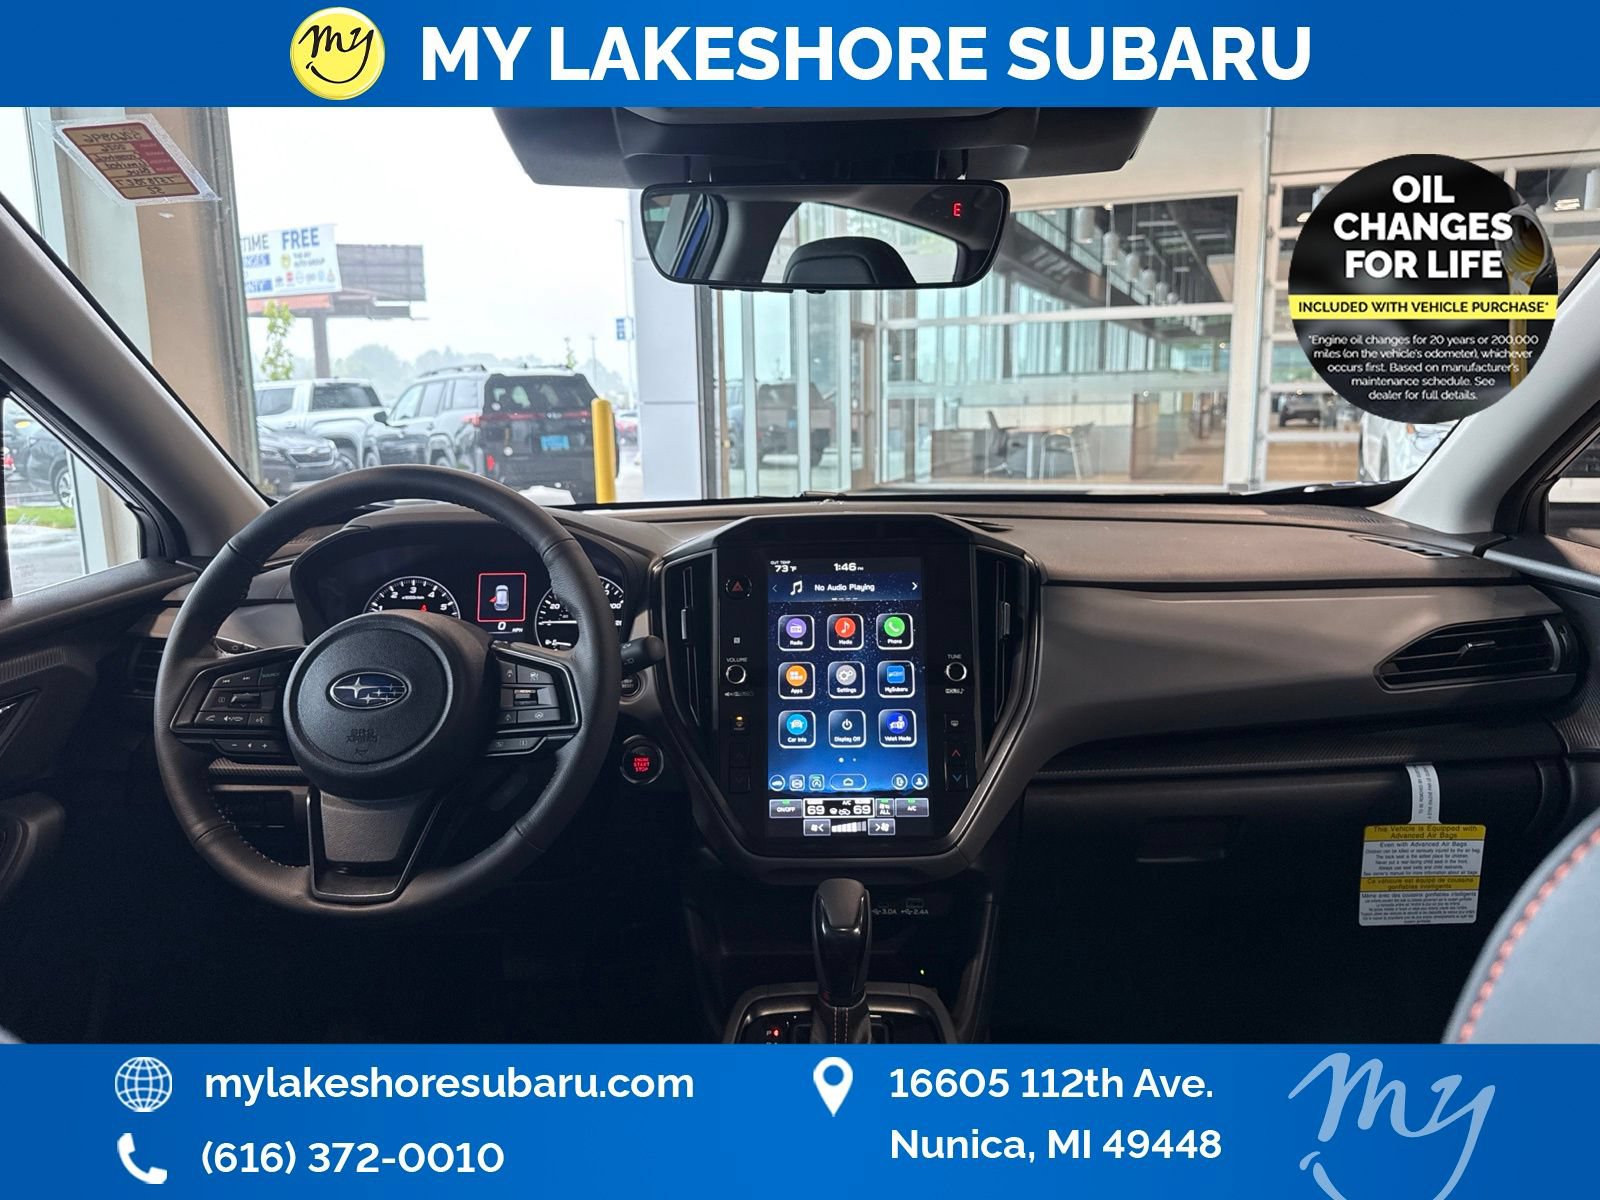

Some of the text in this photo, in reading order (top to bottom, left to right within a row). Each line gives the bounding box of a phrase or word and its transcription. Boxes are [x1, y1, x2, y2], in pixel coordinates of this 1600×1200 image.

[954, 203, 961, 217] E
[282, 227, 320, 250] FREE
[833, 562, 857, 571] 1:46
[827, 583, 847, 591] Audio
[849, 583, 875, 592] Playing
[497, 622, 506, 630] 0
[807, 805, 825, 815] 69
[853, 805, 871, 815] 69
[1440, 832, 1458, 840] Bags
